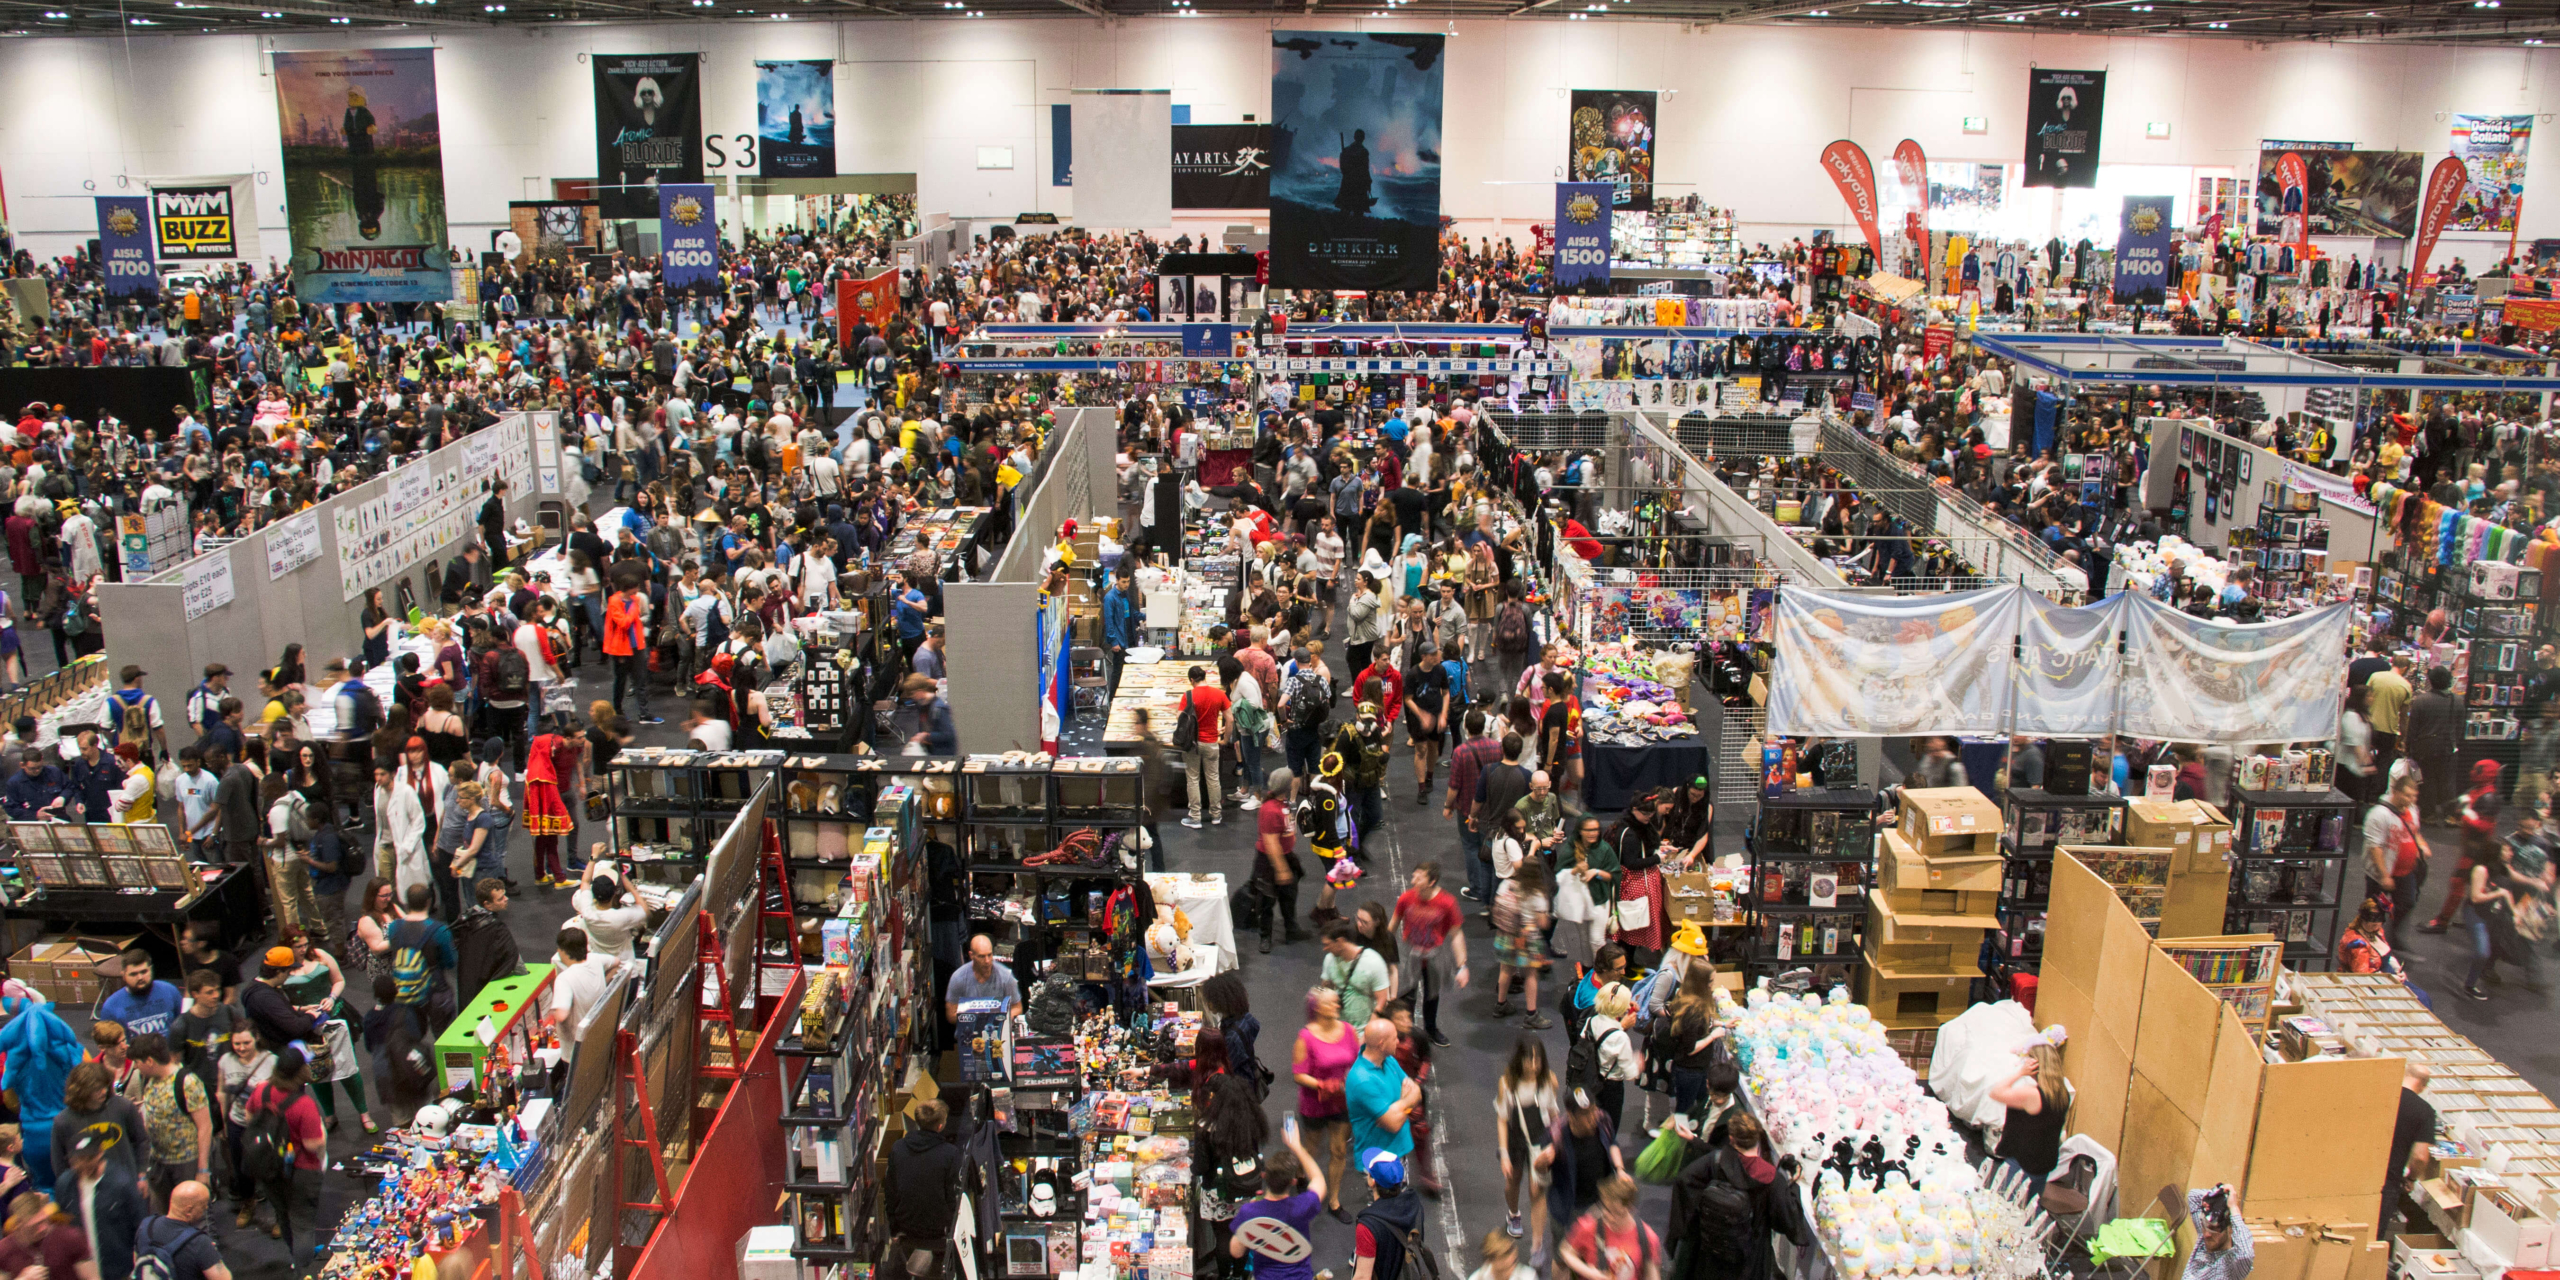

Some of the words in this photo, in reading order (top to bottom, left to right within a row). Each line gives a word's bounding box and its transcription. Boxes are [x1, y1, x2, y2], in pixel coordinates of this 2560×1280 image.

[2471, 121, 2502, 132] David
[2503, 121, 2511, 132] &
[2043, 133, 2086, 149] BLONDE
[2470, 132, 2511, 144] Goliath
[622, 142, 683, 163] BLONDE
[705, 134, 727, 168] S
[735, 134, 756, 168] 3
[164, 220, 227, 240] BUZZ
[164, 246, 187, 254] NEWS
[197, 245, 232, 253] REVIEWS
[1309, 242, 1399, 254] DUNKIRK
[322, 250, 421, 275] NINJAGO
[666, 250, 713, 267] 1600
[1559, 249, 1606, 265] 1500
[108, 260, 150, 276] 1700
[369, 268, 404, 277] MOVIE
[2121, 260, 2164, 275] 1400
[1638, 280, 1673, 296] HARD
[2447, 307, 2473, 315] Goliath
[2448, 300, 2468, 308] David
[2504, 304, 2532, 316] Cosplay
[2329, 490, 2349, 501] LARGE
[277, 536, 294, 551] Scripts
[303, 524, 316, 537] each
[287, 547, 295, 557] for
[295, 542, 305, 553] £25
[296, 554, 306, 566] £40
[200, 572, 211, 584] £10
[212, 566, 227, 579] each
[186, 597, 190, 606] 3
[191, 592, 200, 604] for
[201, 586, 212, 599] £25
[187, 610, 192, 619] 5
[192, 605, 201, 617] for
[203, 599, 214, 612] £40
[1024, 1078, 1068, 1086] ZEKROM
